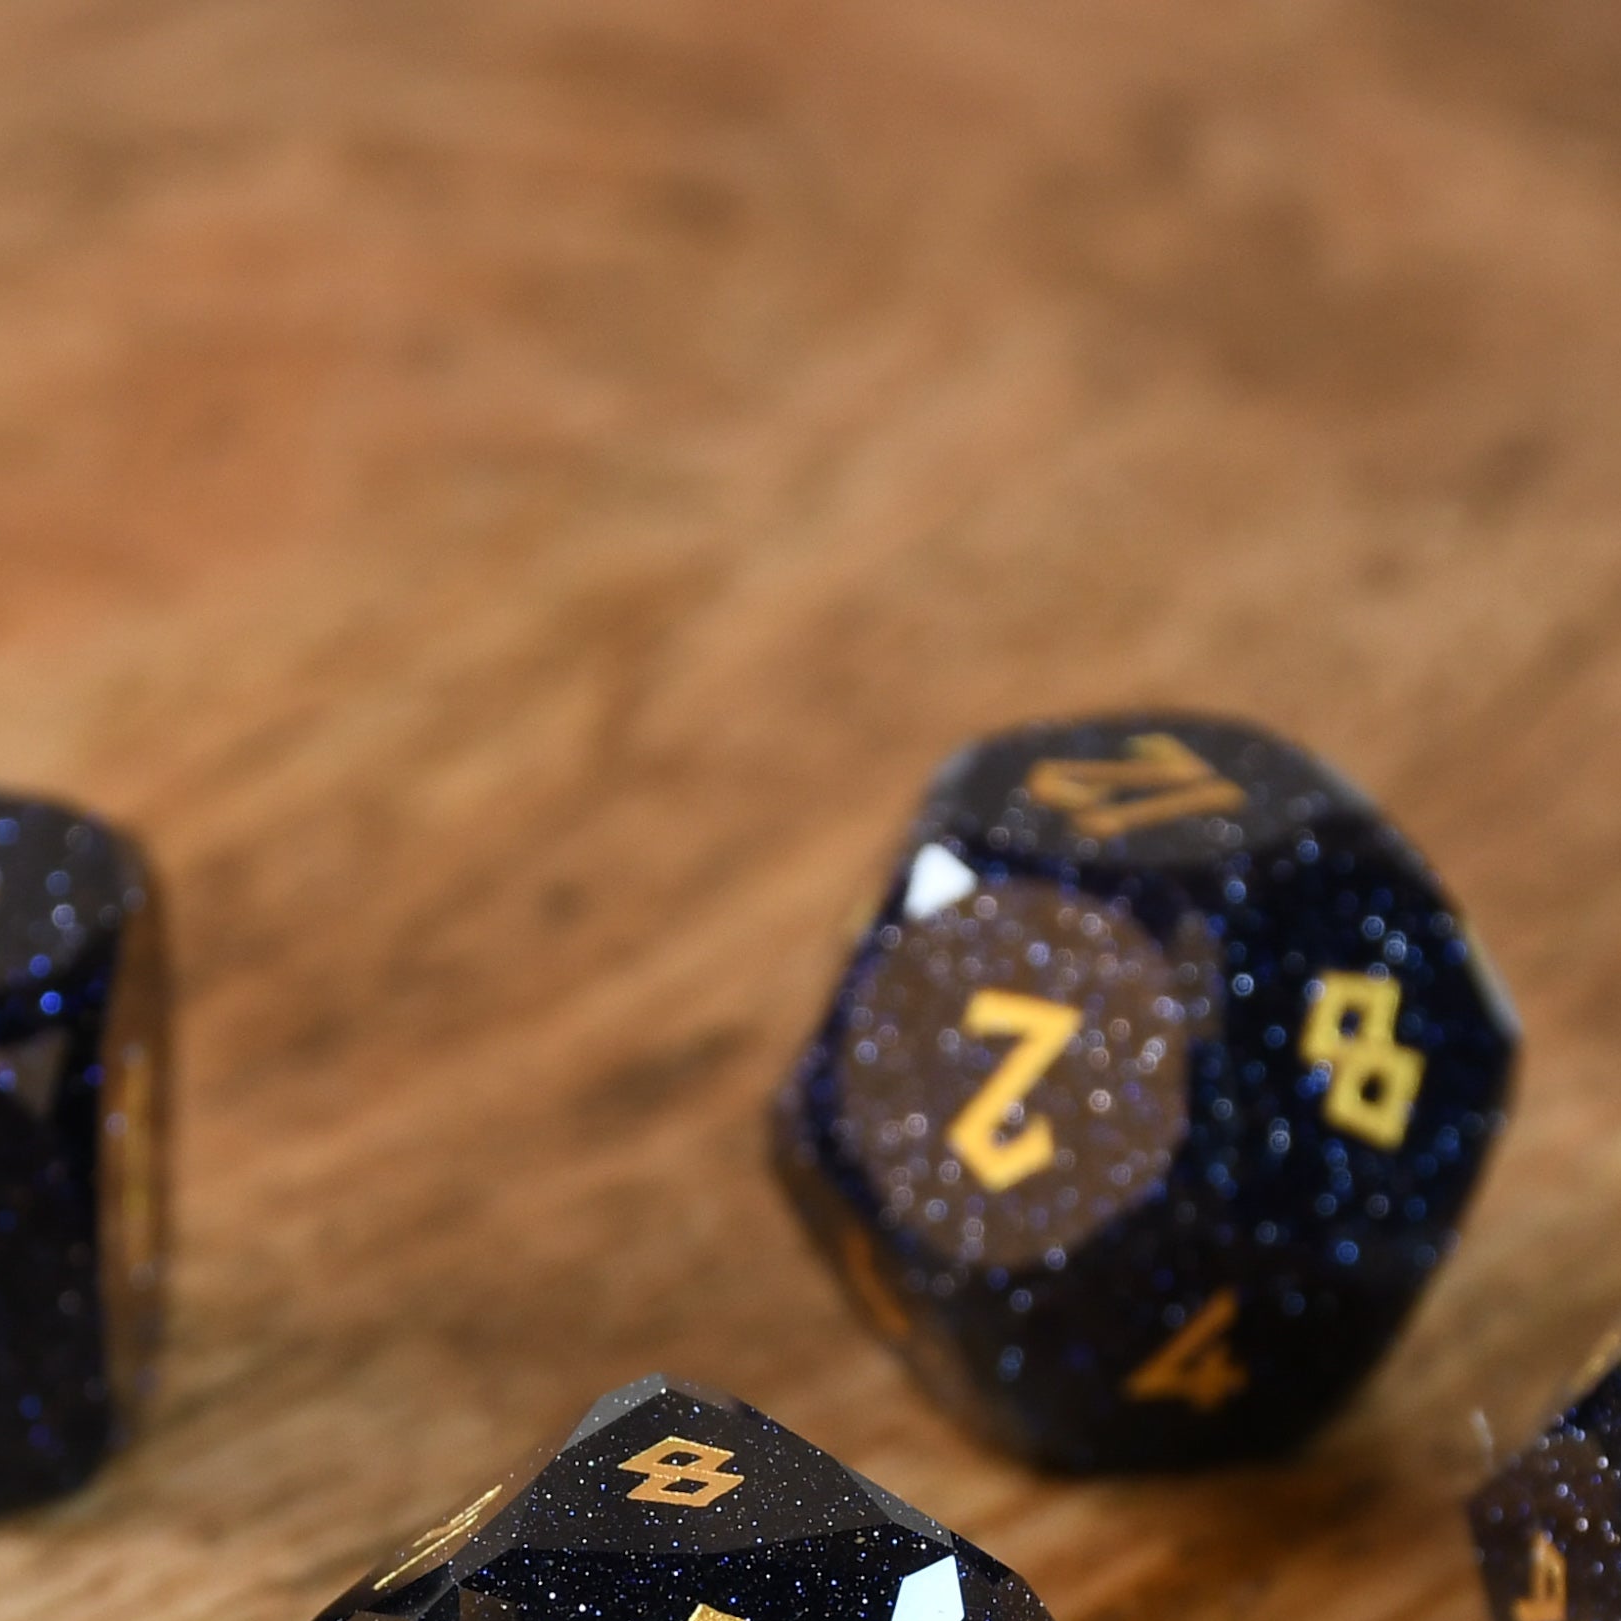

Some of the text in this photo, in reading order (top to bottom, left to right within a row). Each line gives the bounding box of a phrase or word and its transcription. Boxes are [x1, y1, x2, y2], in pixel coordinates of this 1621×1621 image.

[953, 991, 1074, 1183] 2
[1301, 973, 1422, 1145] 8
[623, 1438, 743, 1507] 8
